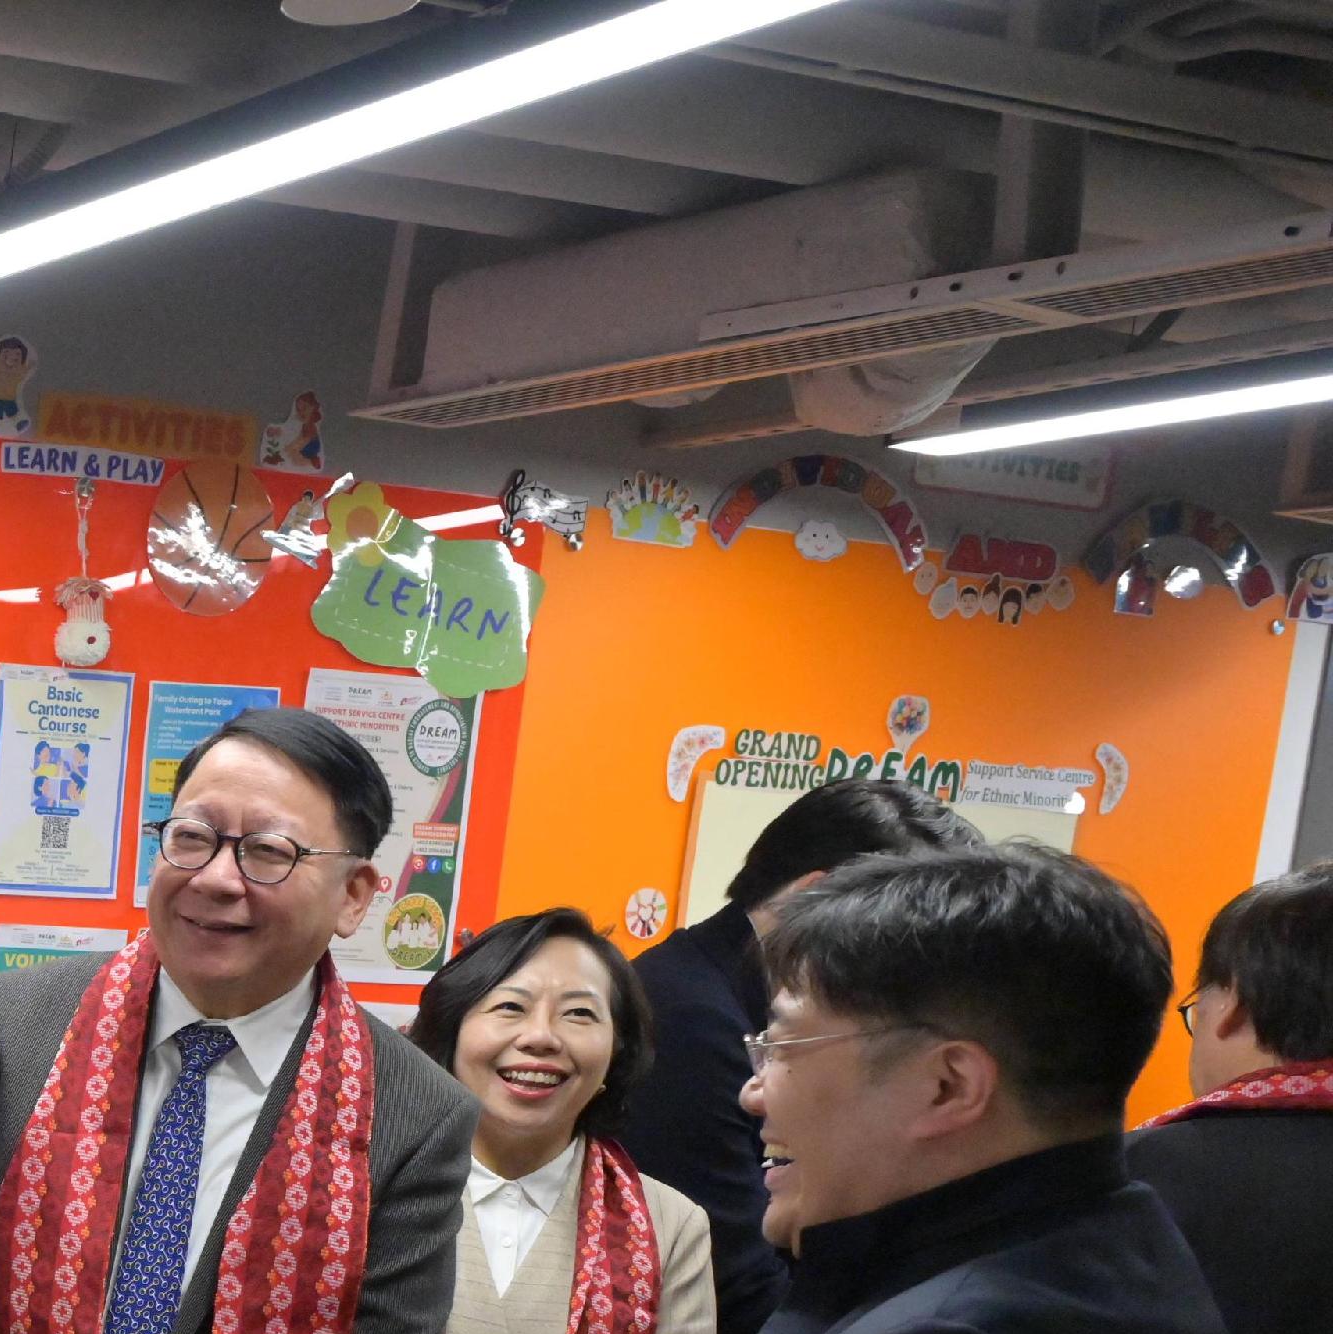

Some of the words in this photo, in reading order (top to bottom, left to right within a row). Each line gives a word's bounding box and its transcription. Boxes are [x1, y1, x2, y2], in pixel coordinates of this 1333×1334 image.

[45, 400, 247, 457] ACTIVITIES
[2, 445, 79, 476] LEARN
[82, 453, 102, 478] &
[106, 456, 165, 485] PLAY
[363, 569, 510, 640] LEARN
[47, 686, 83, 702] Basic
[28, 701, 100, 719] Cantonese
[38, 717, 87, 734] Course
[420, 725, 457, 740] DREAM
[735, 728, 822, 762] GRAND
[715, 758, 825, 791] OPENING
[825, 747, 962, 803] DREAM
[967, 760, 1013, 779] Support
[1016, 764, 1055, 781] Service
[1058, 771, 1095, 785] Centre
[960, 787, 980, 805] for
[981, 787, 1020, 805] Ethnic
[1022, 791, 1073, 808] Minoriti
